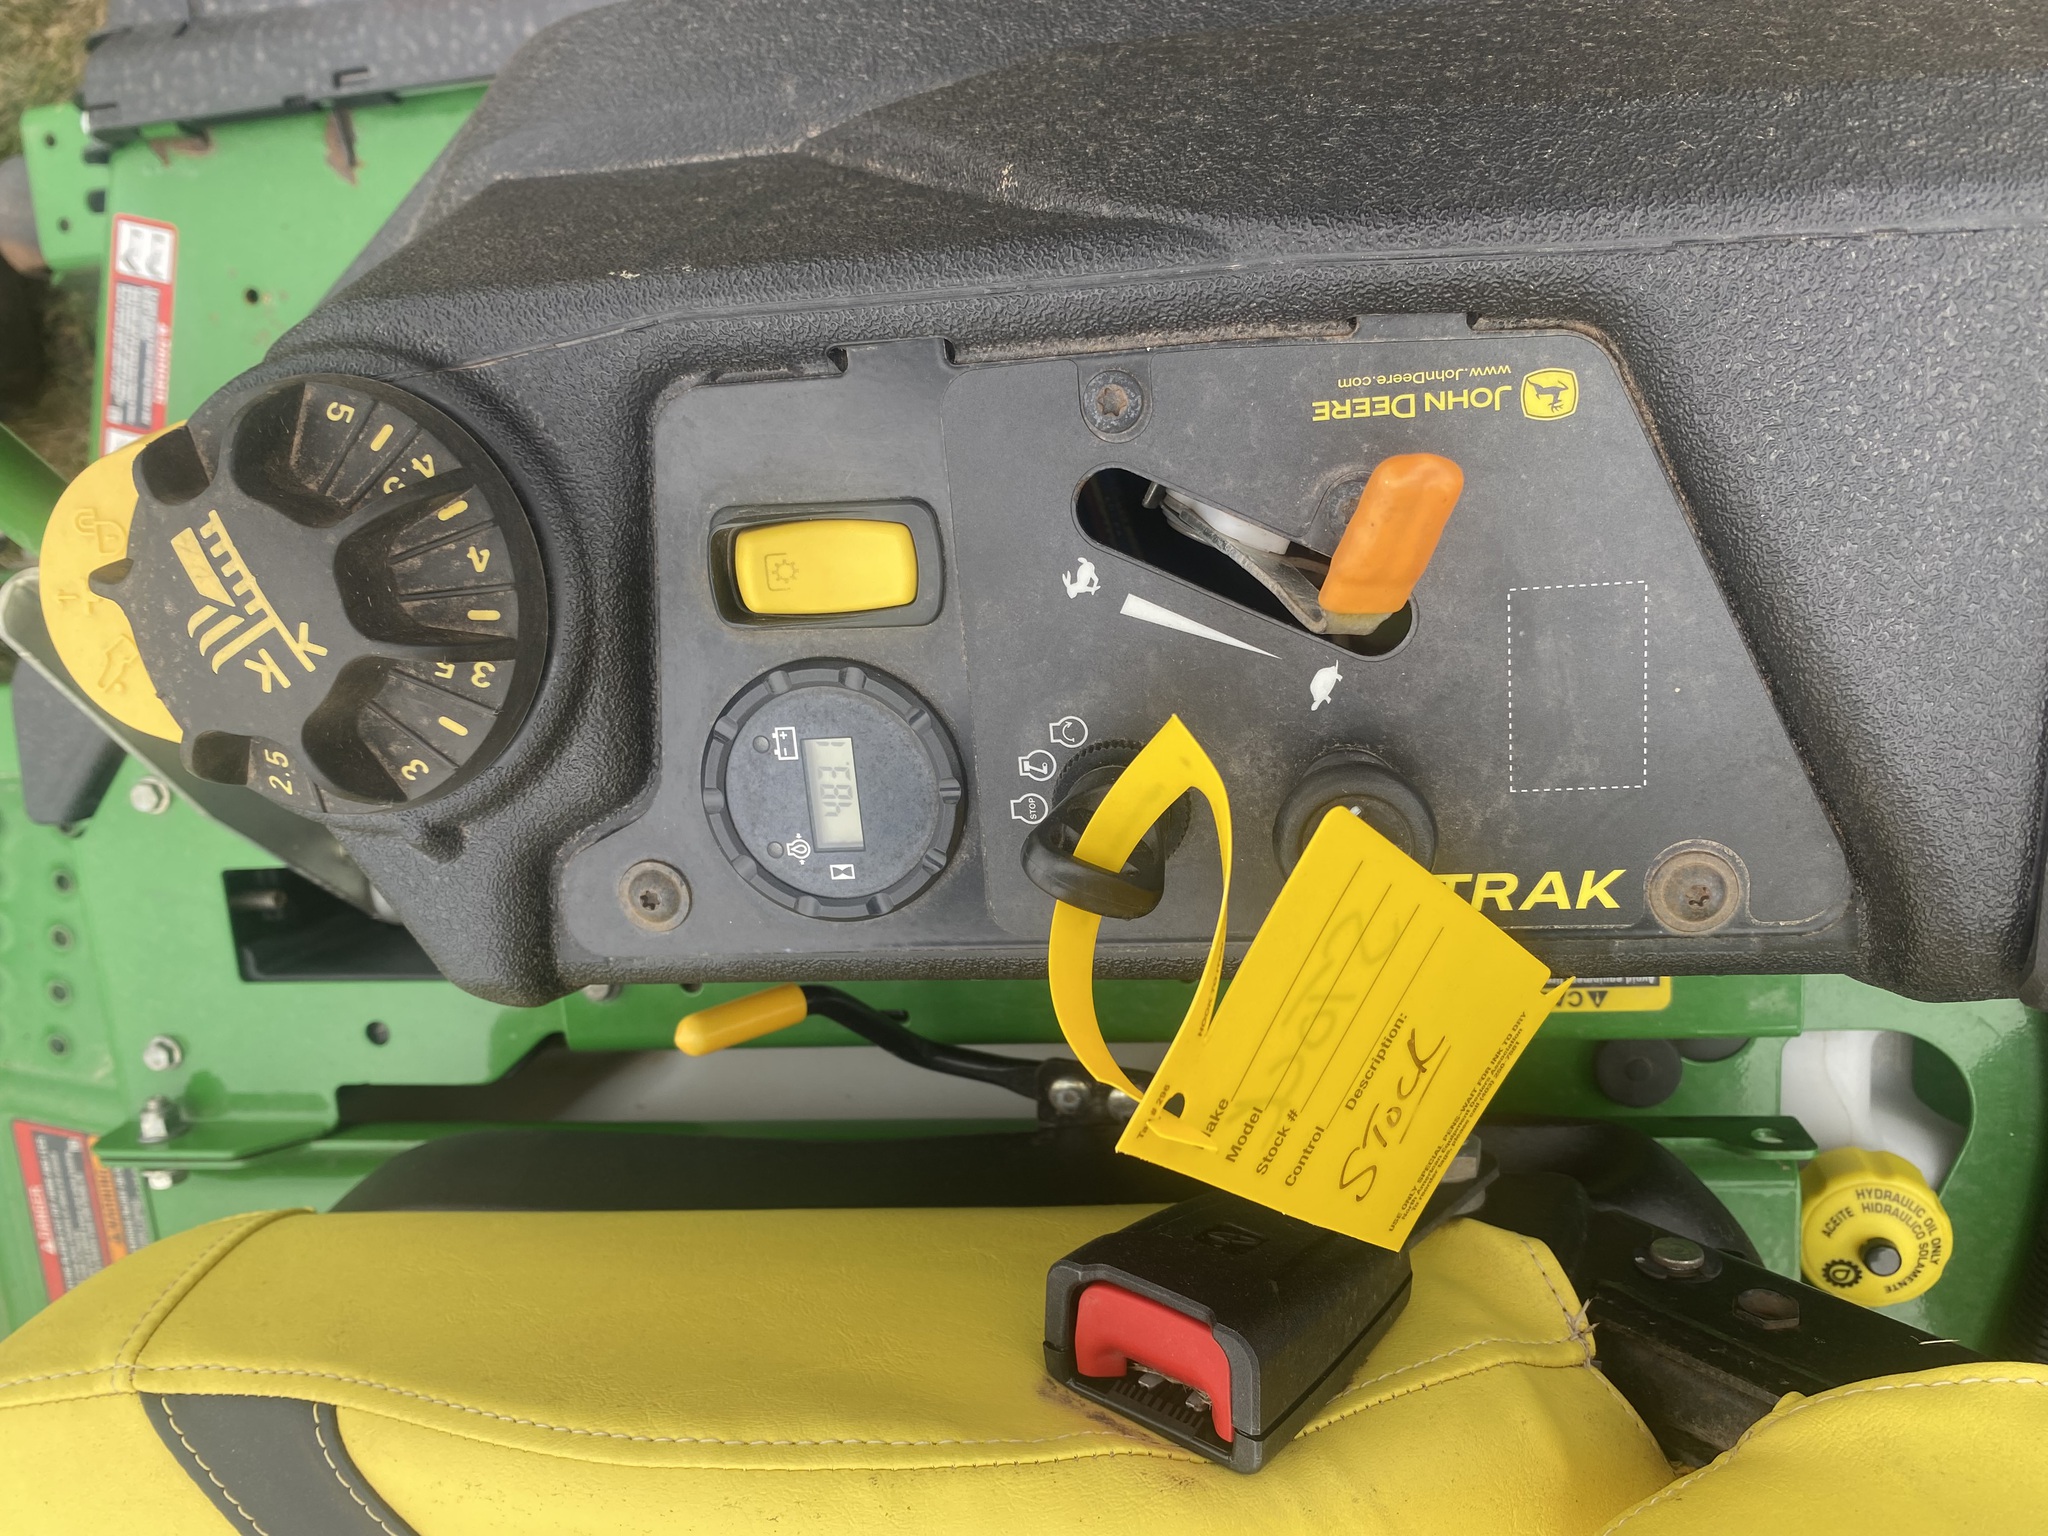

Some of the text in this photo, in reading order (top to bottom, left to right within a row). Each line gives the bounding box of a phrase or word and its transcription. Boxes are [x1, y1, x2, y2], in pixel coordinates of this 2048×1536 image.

[1337, 365, 1512, 388] www.JohnDeere.com
[326, 401, 354, 423] 5
[1312, 385, 1513, 422] JOHN DEERE
[466, 546, 490, 572] 4
[265, 749, 293, 795] 2.5
[400, 758, 430, 782] 3
[1029, 797, 1037, 820] STOP
[1344, 1012, 1408, 1111] Description:
[1156, 1084, 1170, 1105] 296
[1225, 1106, 1263, 1163] Model
[1256, 1108, 1298, 1175] Stock #
[1389, 1212, 1403, 1232] USE
[1401, 1184, 1418, 1211] ONLY
[1417, 1145, 1444, 1183] SPECIAL
[1477, 1067, 1492, 1086] FOR
[1491, 1047, 1504, 1065] INK
[1502, 1031, 1514, 1045] TO
[1512, 1011, 1527, 1030] DRY
[1285, 1125, 1325, 1187] Control
[1416, 1154, 1443, 1195] American
[1440, 1109, 1472, 1155] Equipment
[1822, 1202, 1929, 1293] ACEITE HIDRAULICO SOLAMENTE
[1855, 1188, 1942, 1265] HYDRAULIC OIL ONLY
